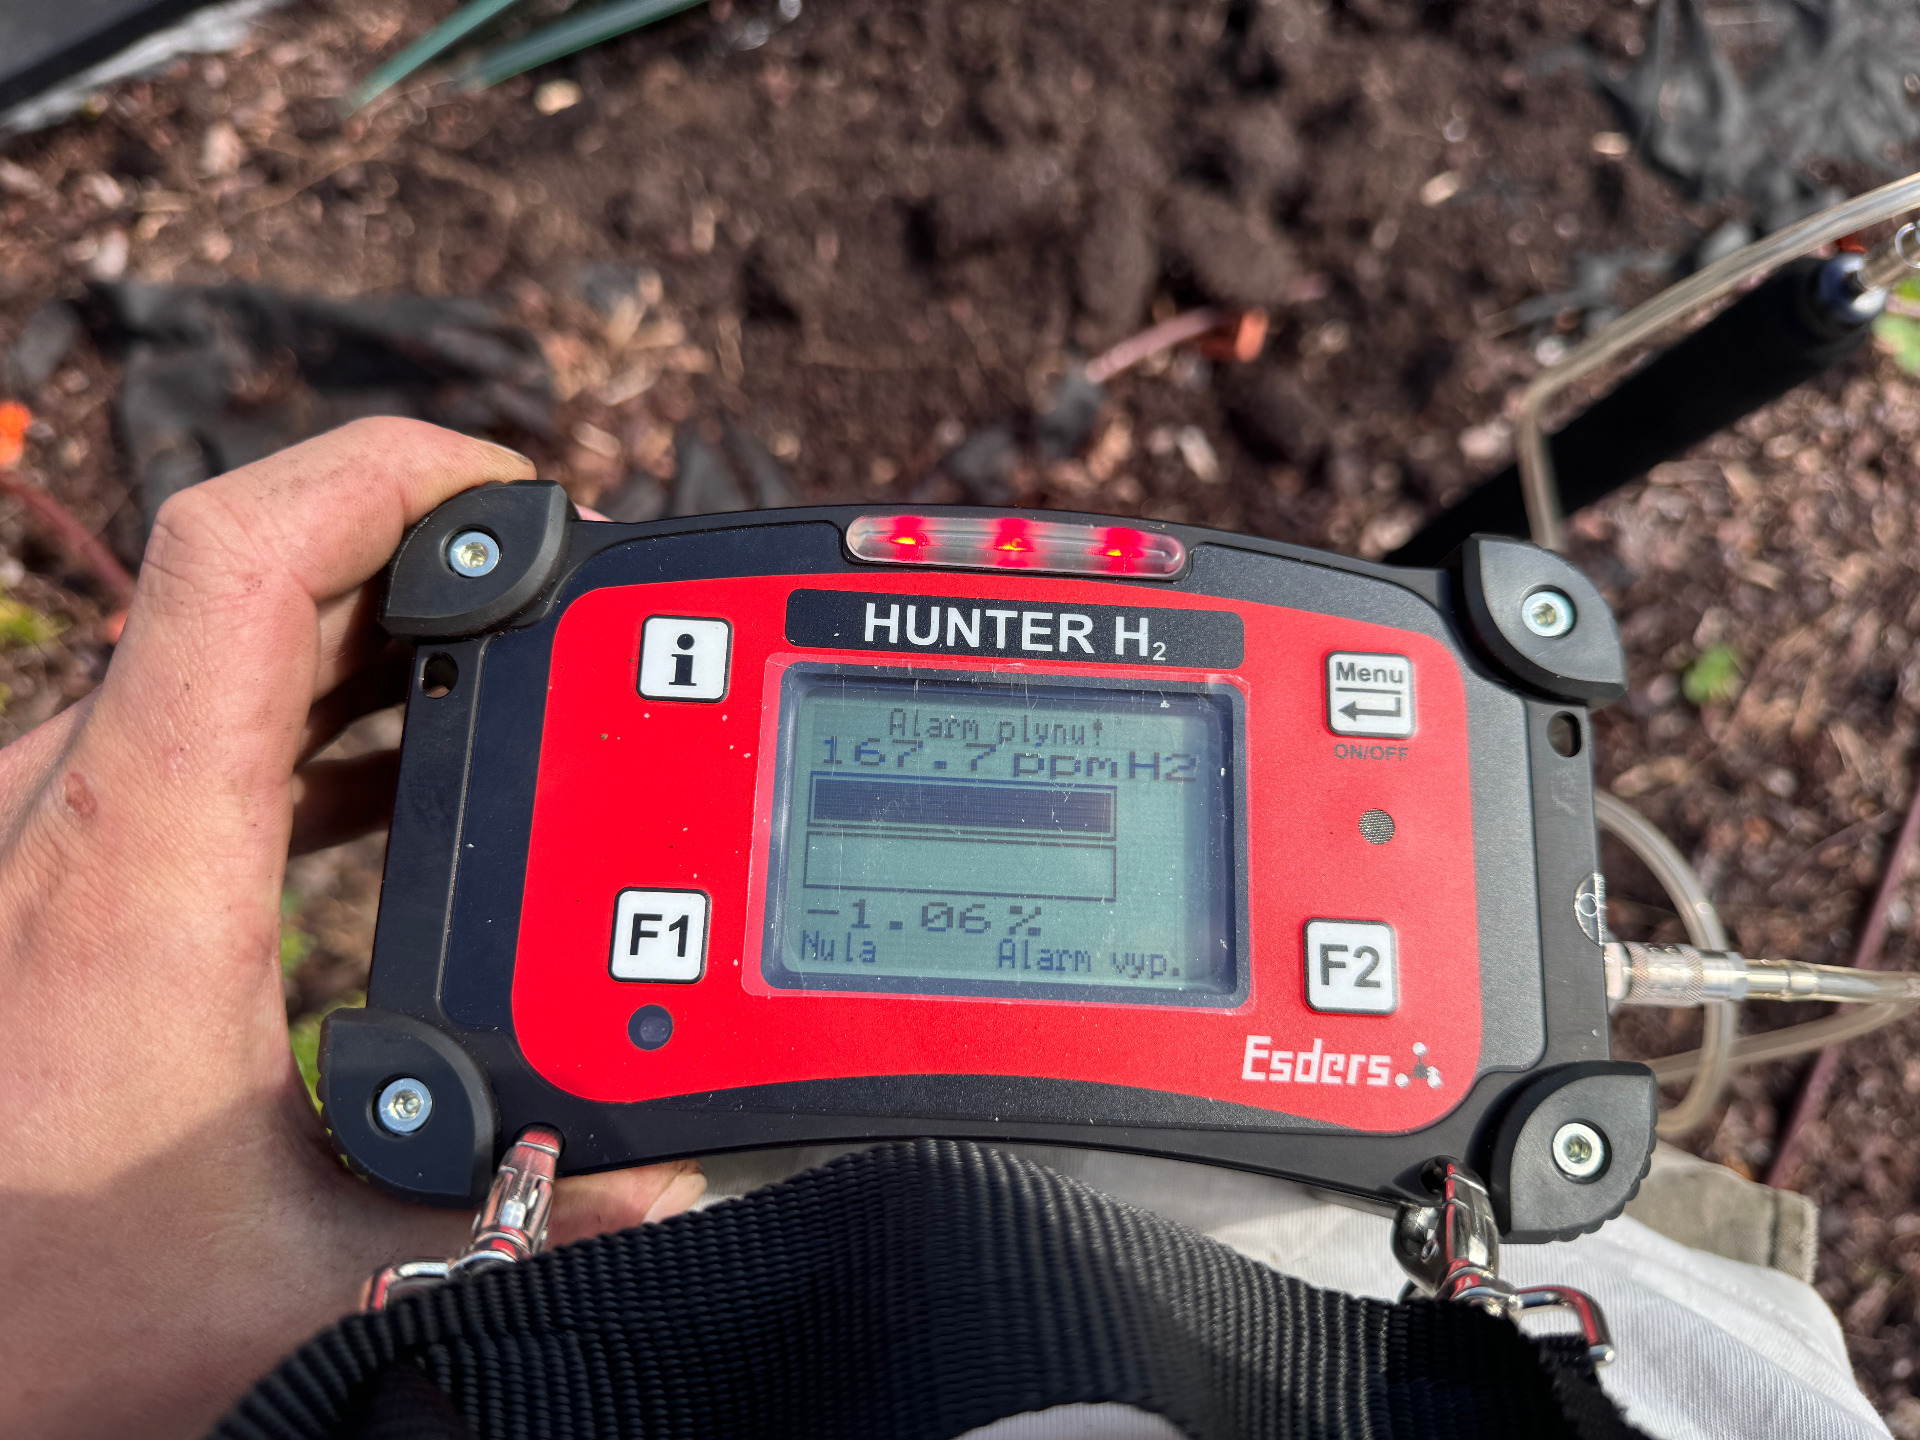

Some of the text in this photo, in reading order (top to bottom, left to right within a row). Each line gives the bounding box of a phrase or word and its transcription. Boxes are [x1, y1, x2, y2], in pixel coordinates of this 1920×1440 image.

[864, 602, 1095, 654] HUNTER
[1334, 661, 1403, 684] Menu
[889, 707, 979, 740] Alarm
[1333, 743, 1409, 761] ON/OFF
[629, 912, 689, 958] F1
[801, 930, 876, 963] Nula
[999, 937, 1180, 979] Alarm vyp.
[1319, 943, 1381, 989] F2
[1241, 1034, 1391, 1087] Esders
